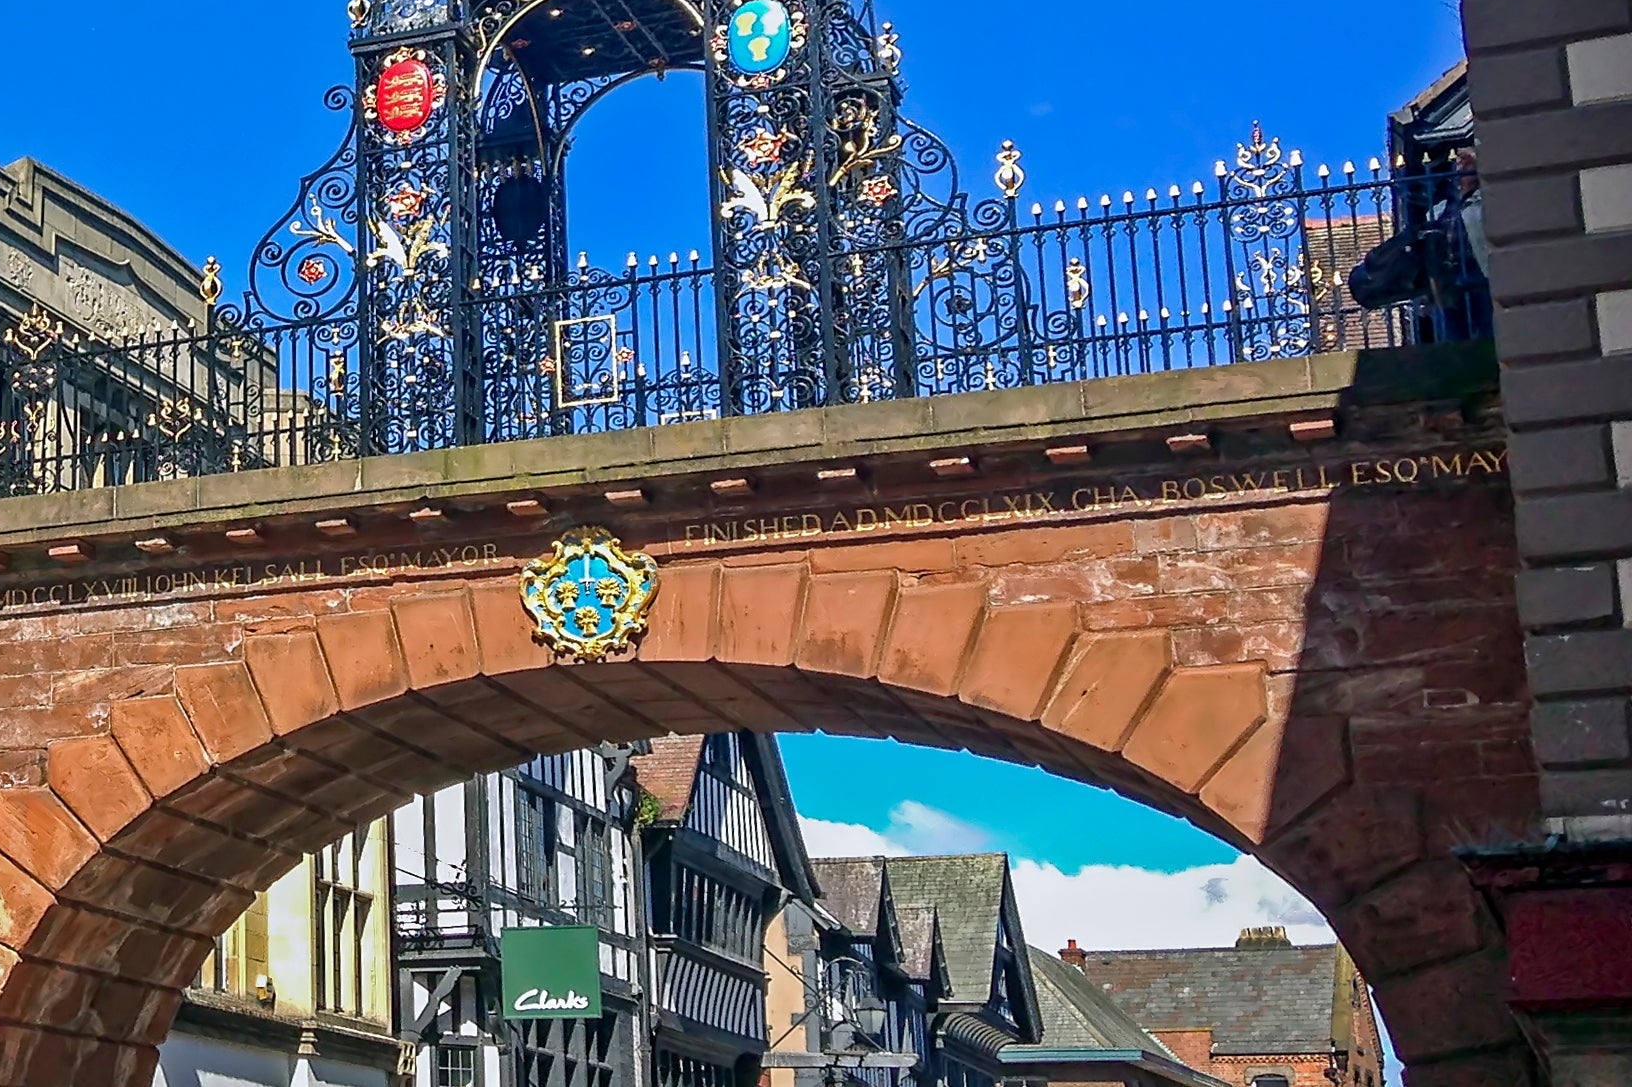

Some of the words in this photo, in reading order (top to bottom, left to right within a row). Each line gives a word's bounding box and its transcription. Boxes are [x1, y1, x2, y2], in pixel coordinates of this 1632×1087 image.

[684, 514, 822, 546] FINISHED
[1161, 465, 1341, 504] BOSWELL
[143, 571, 207, 602] JOHN
[214, 559, 329, 591] KELSALL
[400, 542, 500, 573] MAYOR
[514, 988, 589, 1011] Clarks
